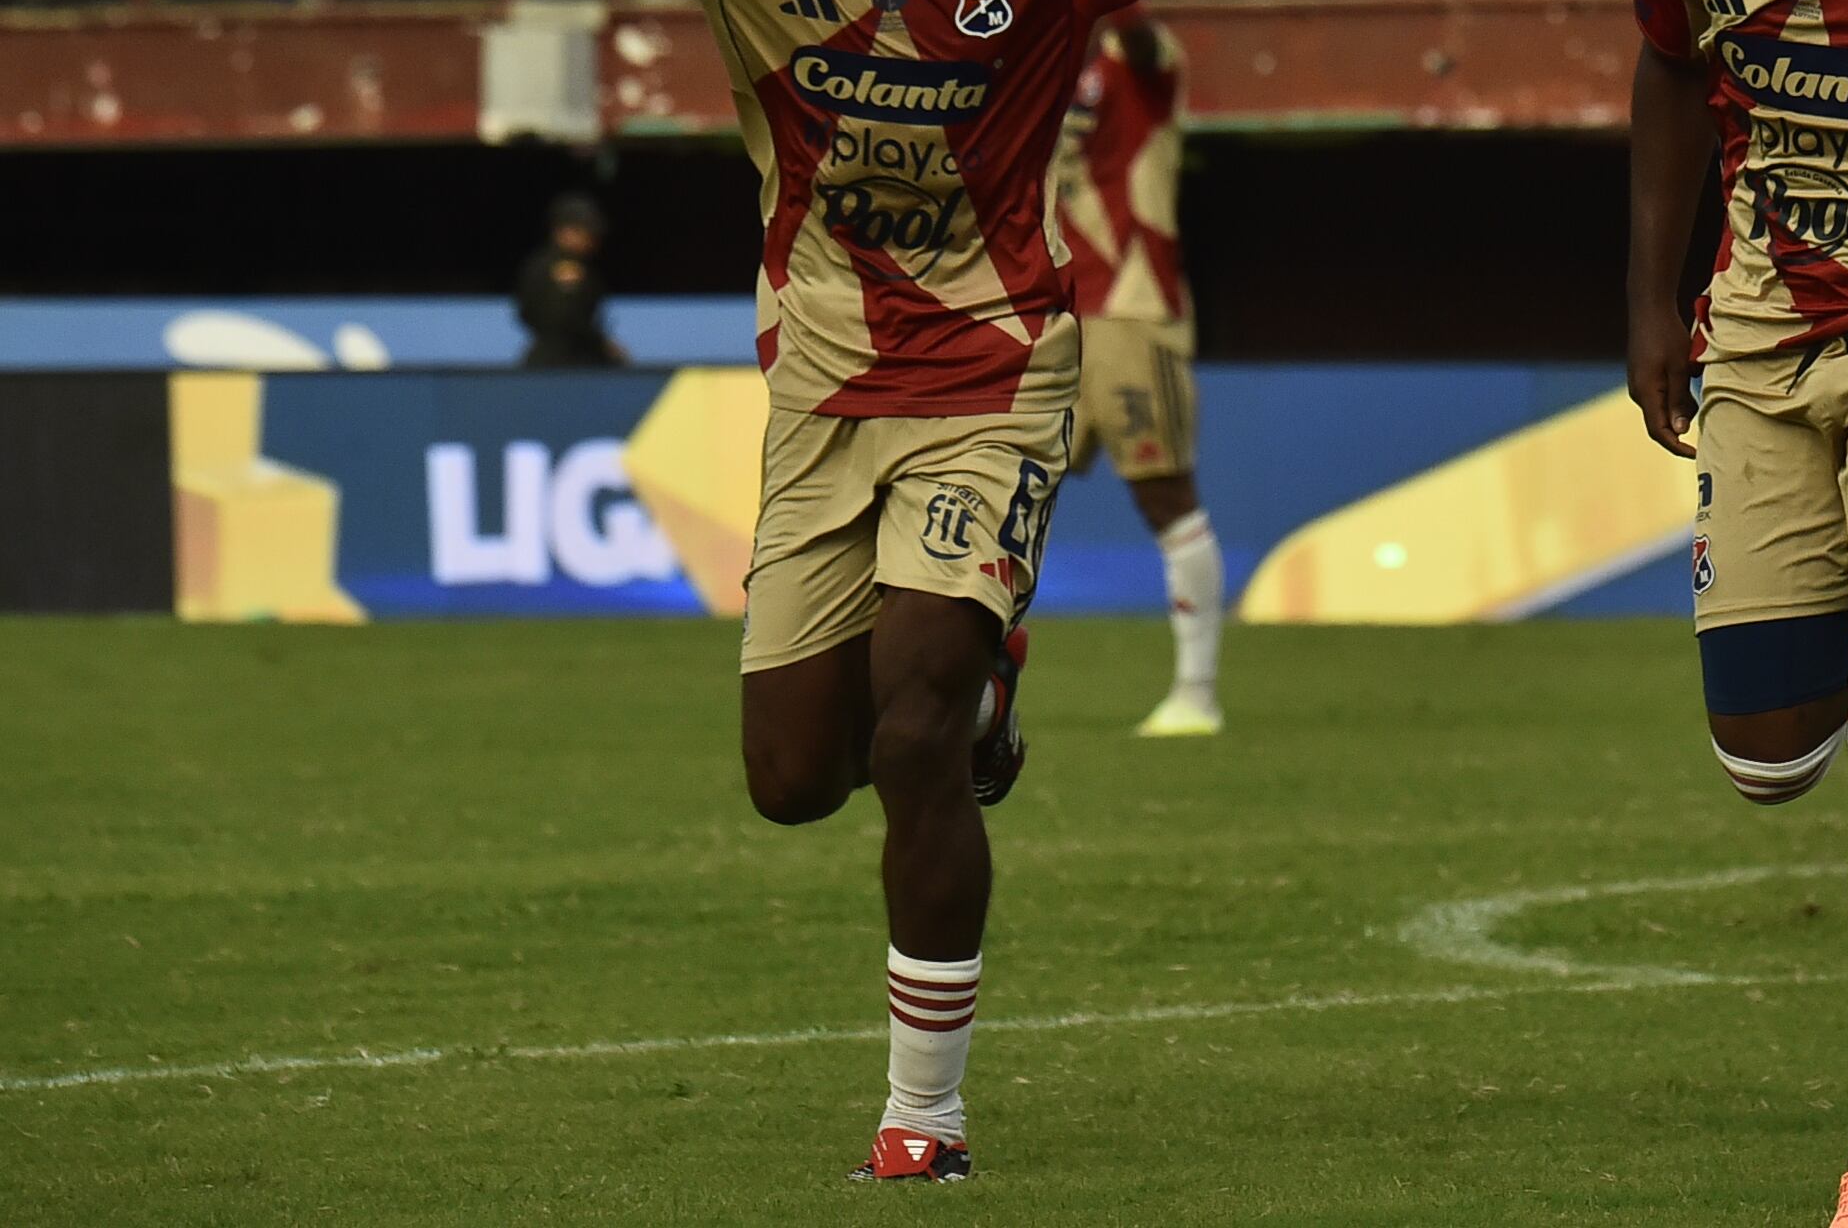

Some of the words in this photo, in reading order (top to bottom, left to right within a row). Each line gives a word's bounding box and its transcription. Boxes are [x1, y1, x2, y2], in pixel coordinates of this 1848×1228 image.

[794, 56, 987, 112] Colanta
[817, 185, 966, 250] Pool
[425, 440, 688, 585] LIG
[923, 493, 975, 549] fit
[937, 483, 985, 512] smart
[998, 458, 1048, 558] 6
